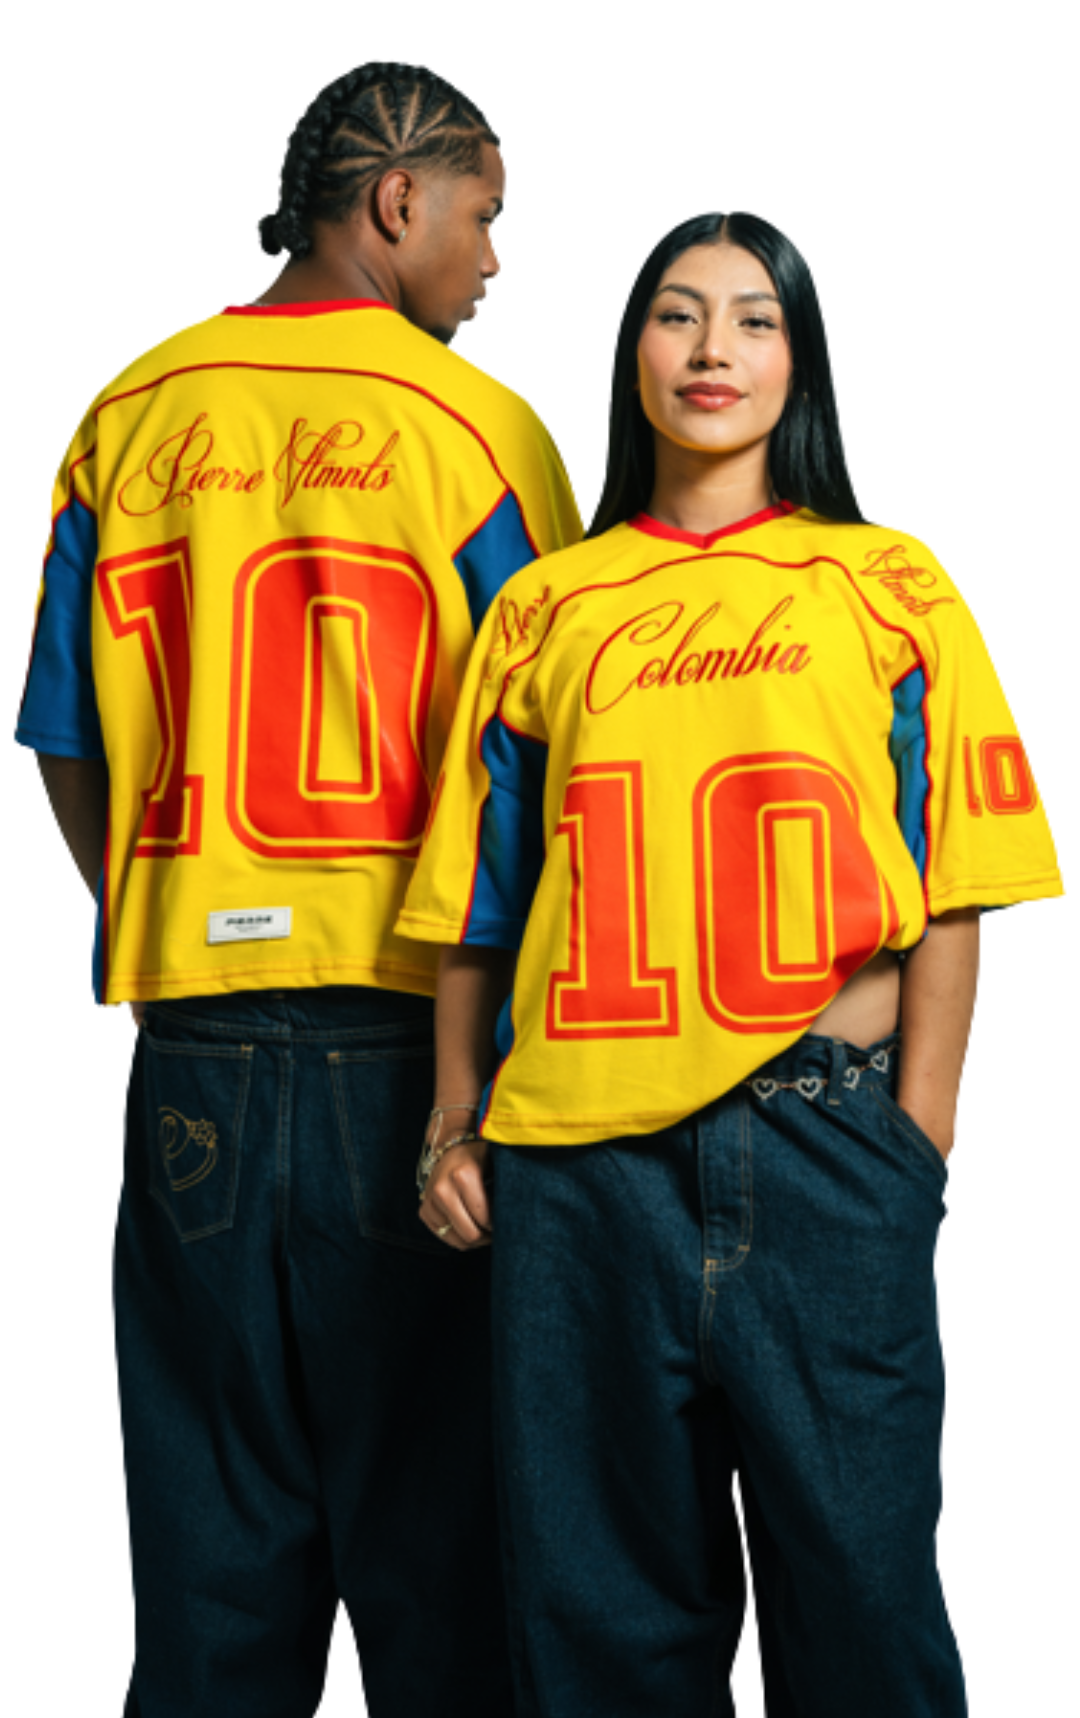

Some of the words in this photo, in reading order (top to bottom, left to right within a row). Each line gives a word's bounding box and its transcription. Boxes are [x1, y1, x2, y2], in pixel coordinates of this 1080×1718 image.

[117, 411, 265, 517] Pierre
[94, 535, 438, 858] 10
[585, 594, 812, 715] Colombia
[962, 733, 1038, 818] 10
[545, 751, 901, 1041] 10
